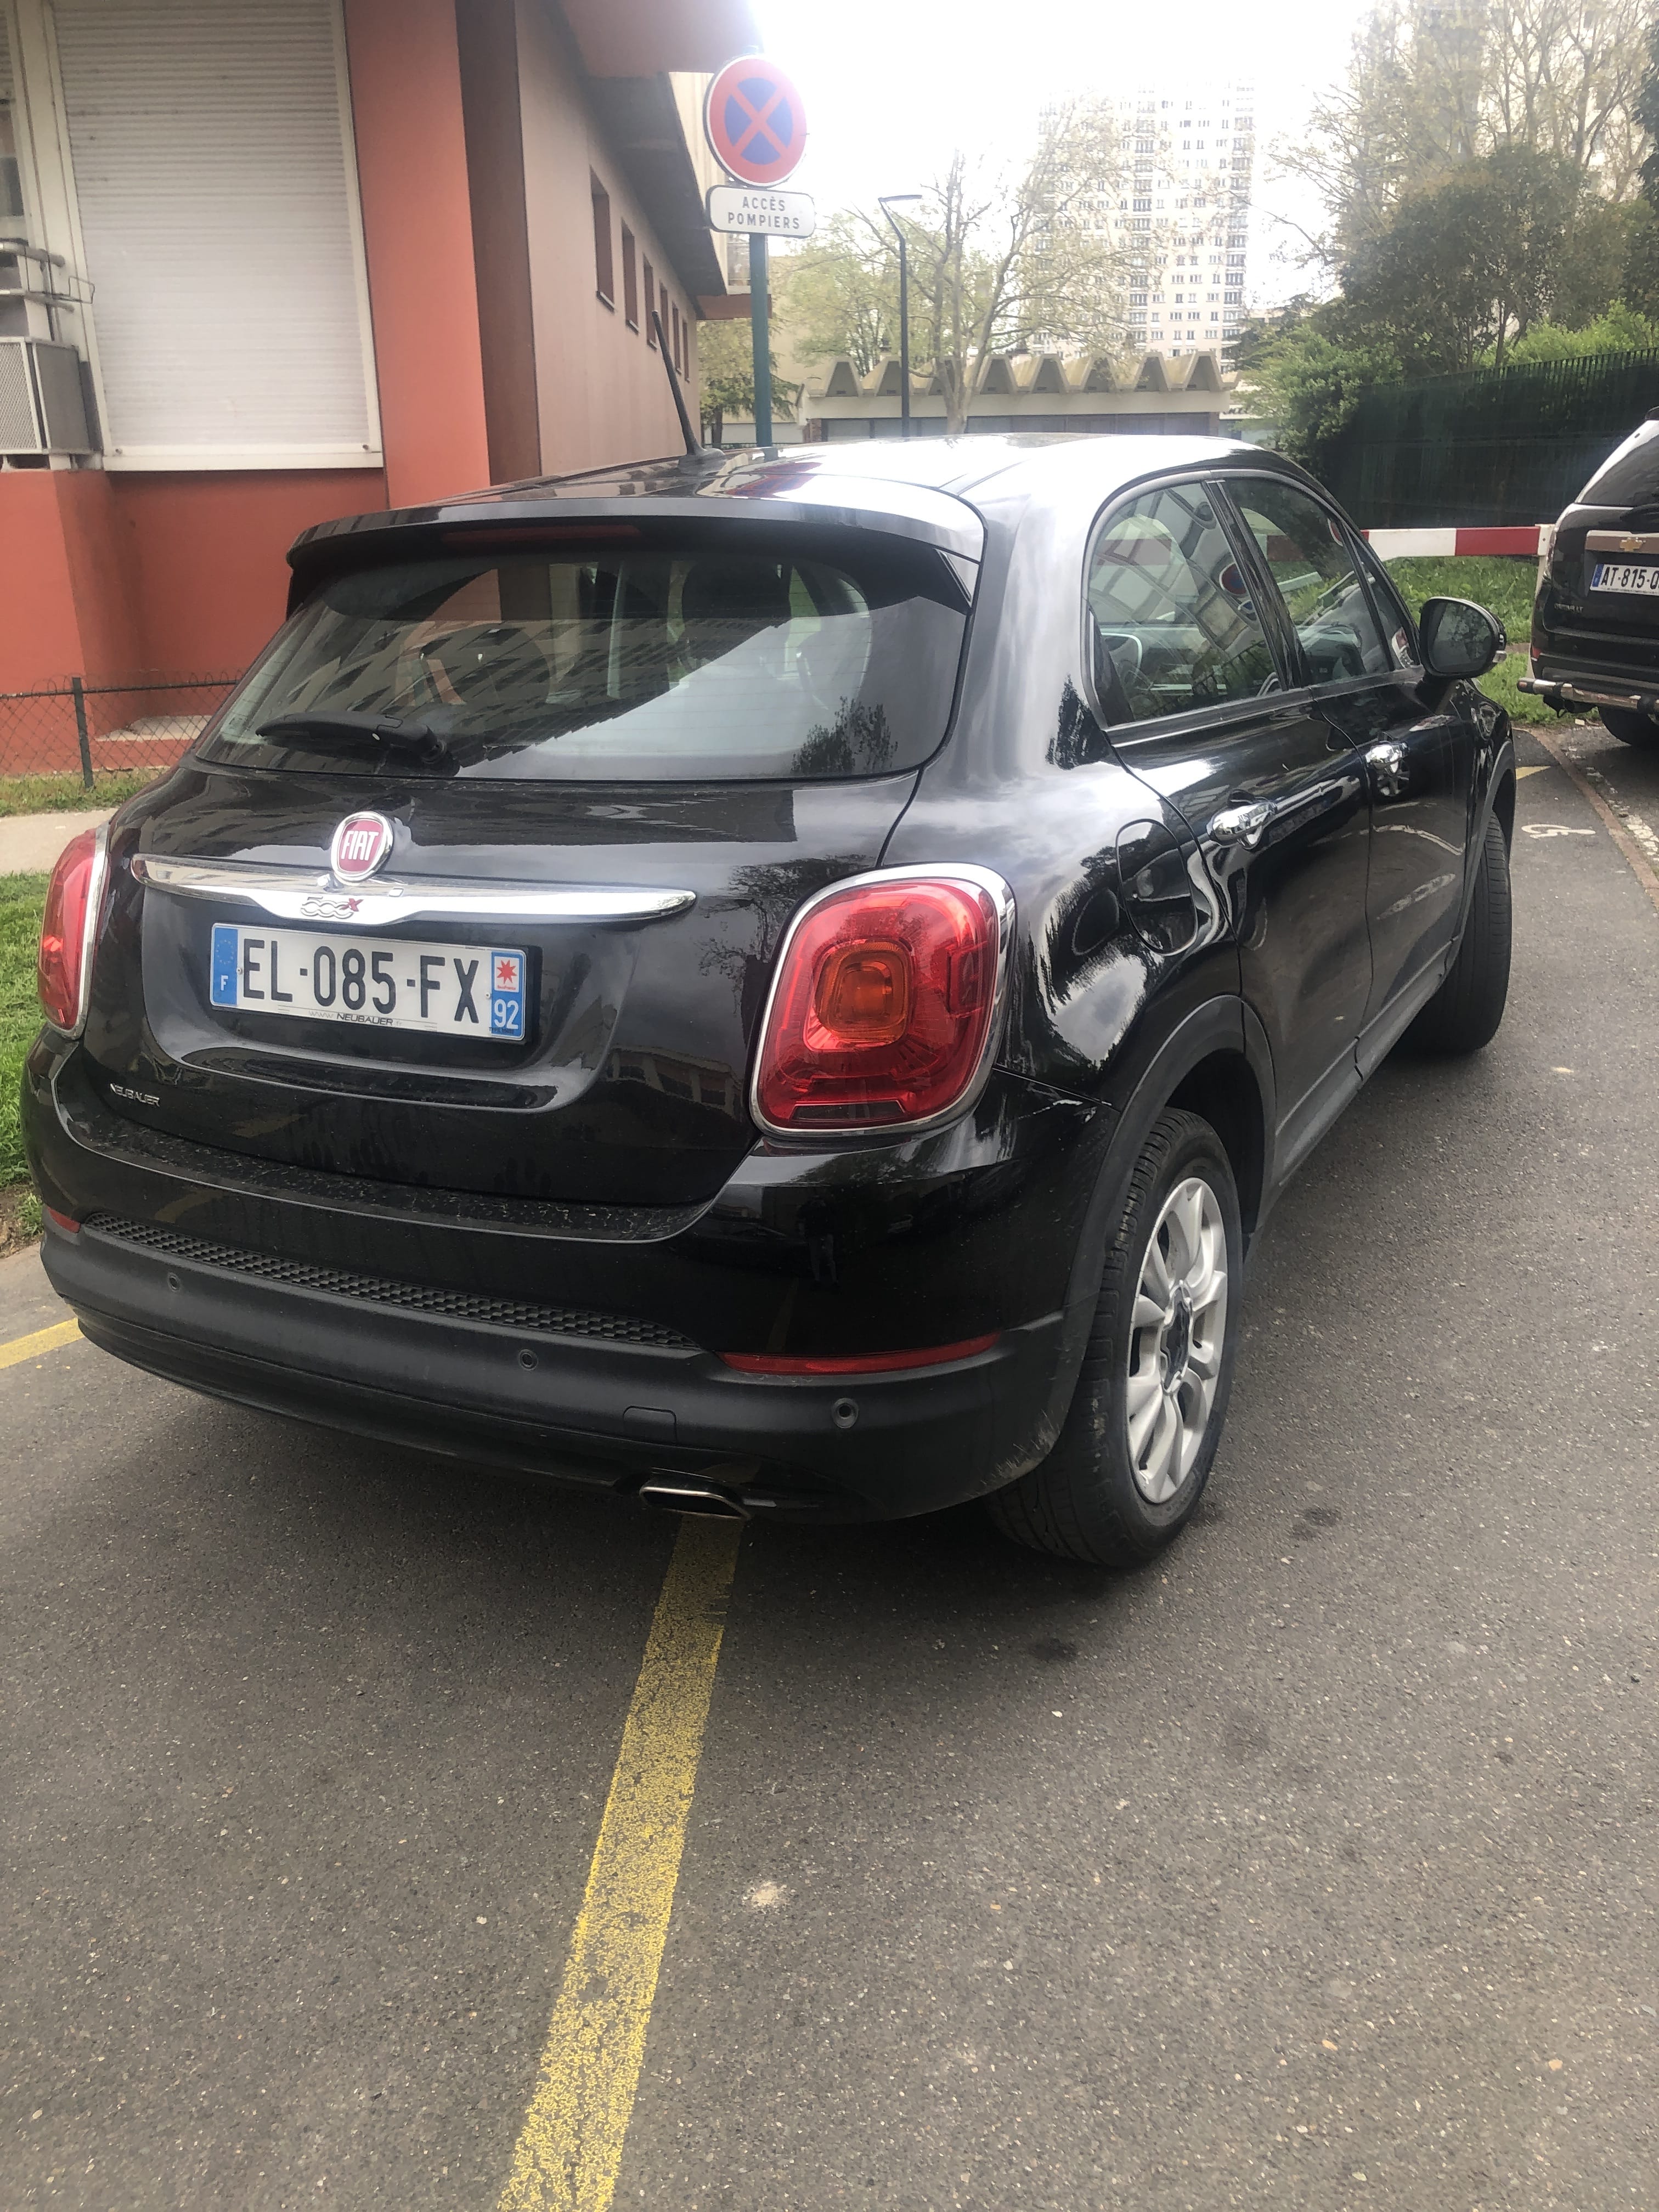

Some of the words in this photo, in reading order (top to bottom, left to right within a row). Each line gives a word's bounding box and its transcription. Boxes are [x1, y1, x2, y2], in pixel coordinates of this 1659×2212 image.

[742, 196, 785, 211] ACCÈS
[728, 212, 800, 229] POMPIERS
[1601, 567, 1659, 589] AT-815-Q
[341, 831, 379, 861] FIAT
[221, 975, 228, 991] F
[243, 939, 479, 1024] EL-085-FX
[336, 1013, 393, 1026] NEUBAUER
[494, 998, 519, 1029] 92
